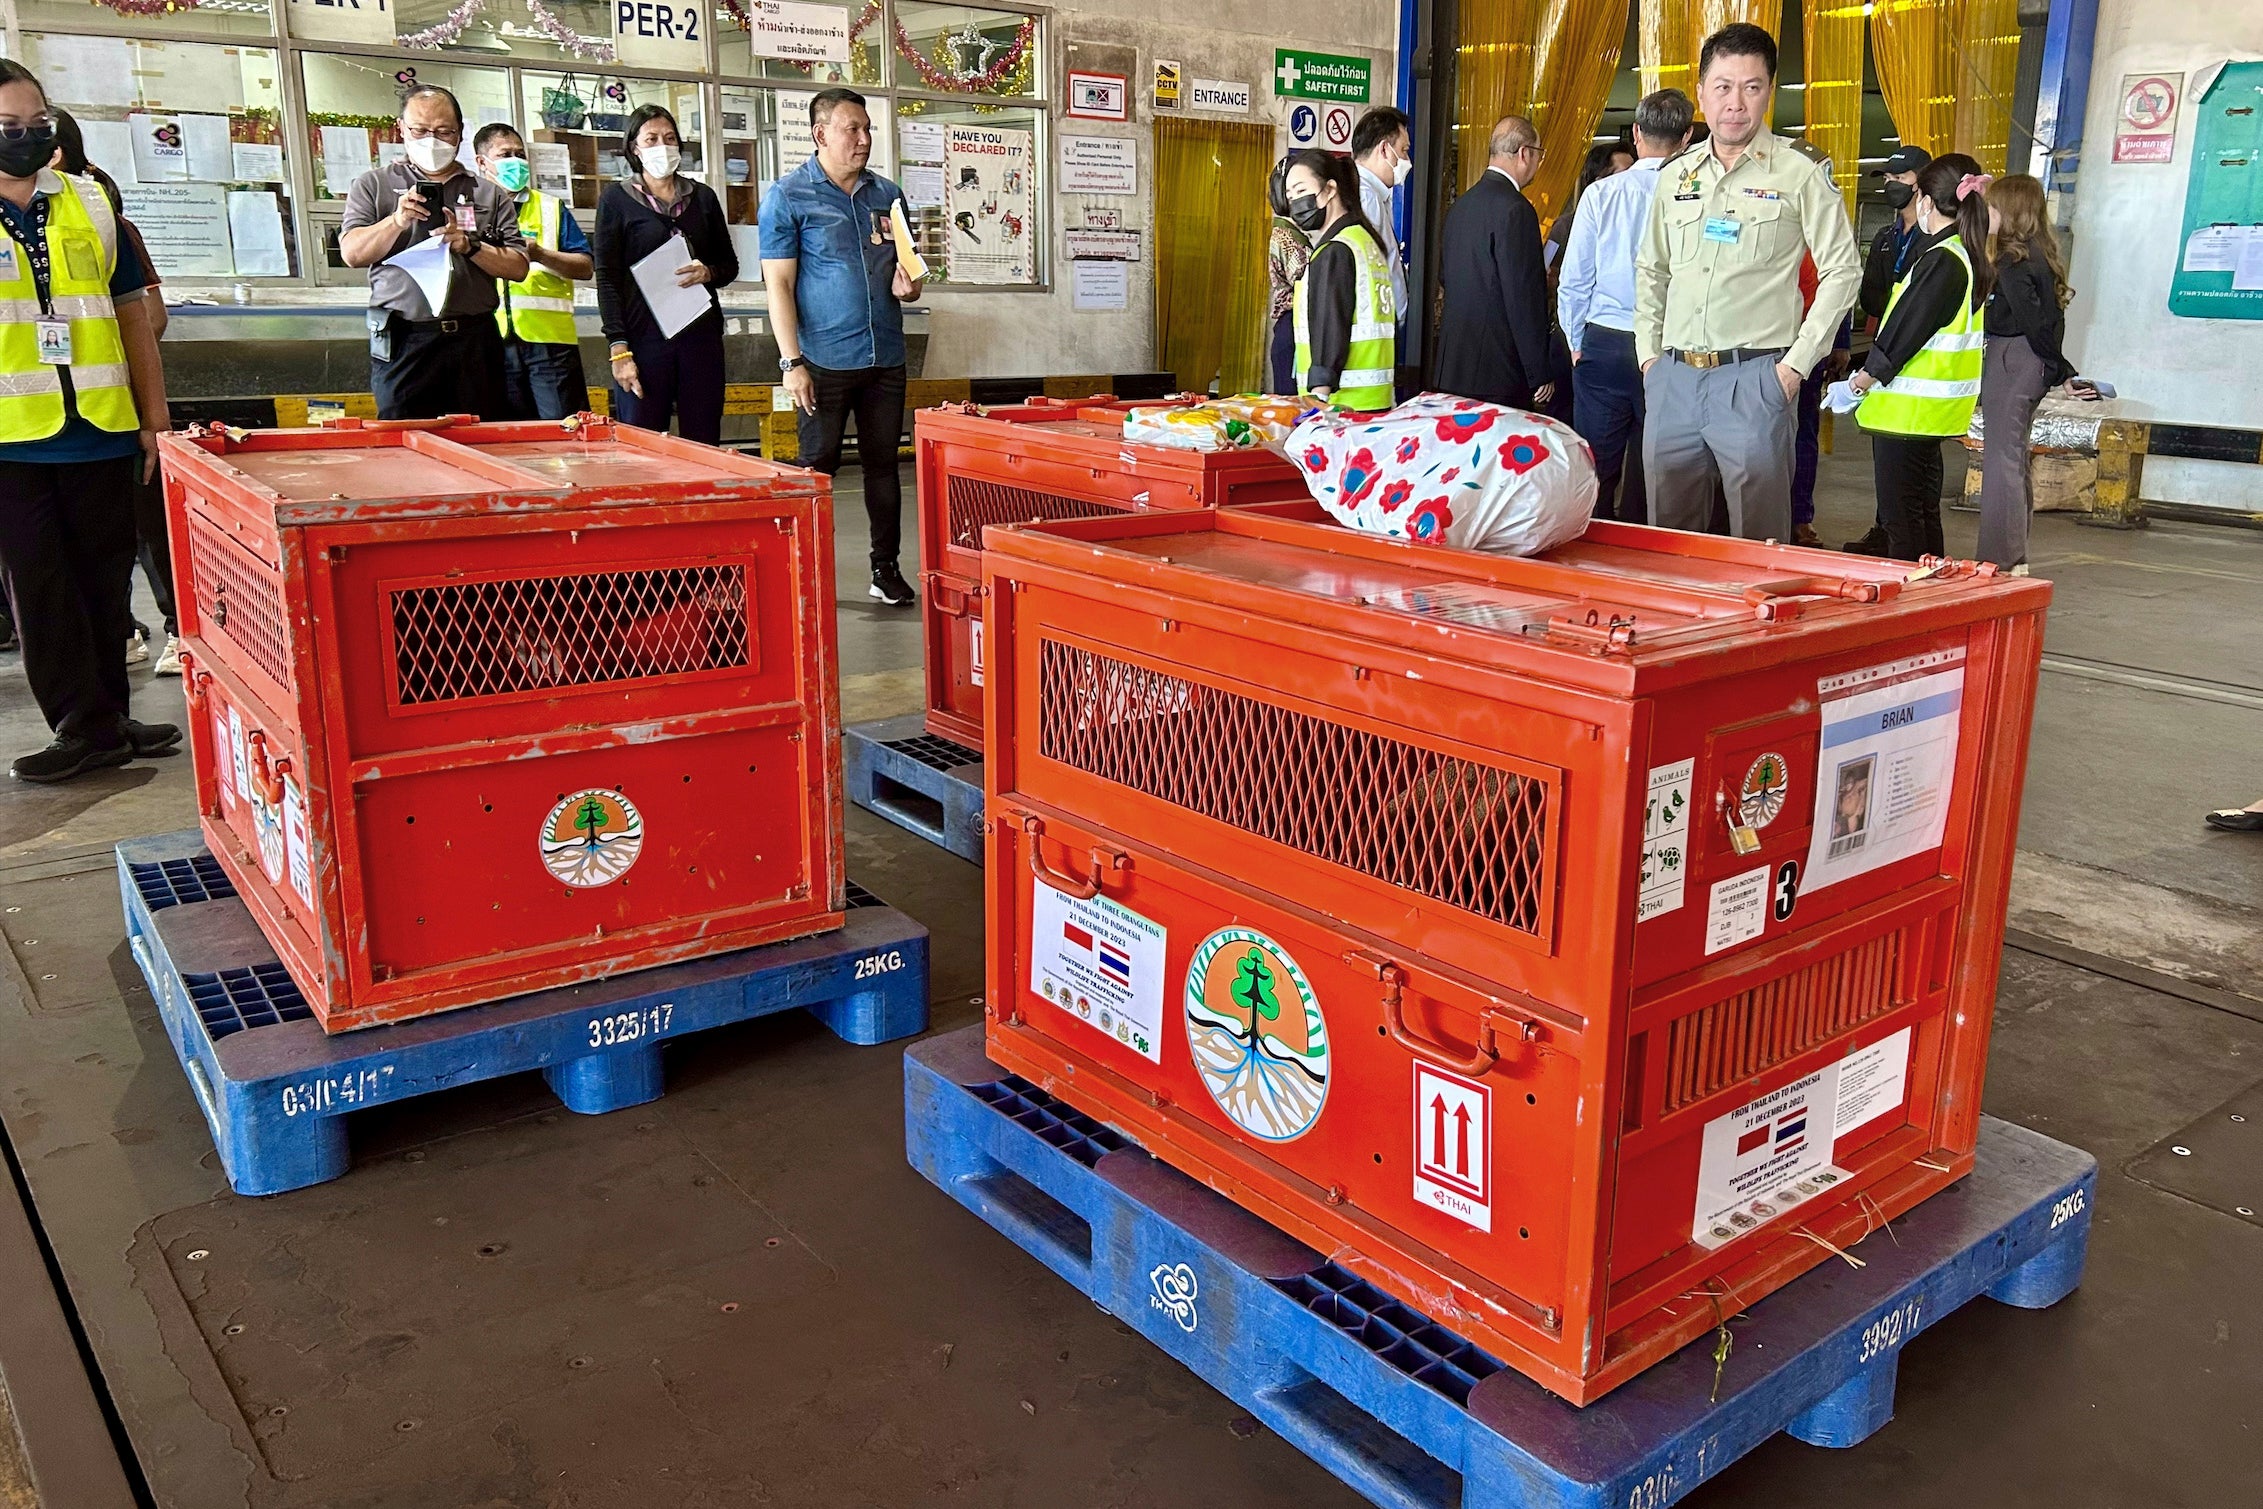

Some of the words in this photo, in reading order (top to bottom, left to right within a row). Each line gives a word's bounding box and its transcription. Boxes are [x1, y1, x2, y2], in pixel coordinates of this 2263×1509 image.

[763, 2, 780, 10] THAI
[618, 1, 699, 41] PER-2
[1304, 60, 1367, 80] ปลอดภัยไว้ก่อน
[1157, 79, 1178, 89] CCTV
[1194, 89, 1247, 106] ENTRANCE
[1305, 80, 1338, 94] SAFETY
[1339, 84, 1364, 97] FIRST
[953, 130, 980, 142] HAVE
[983, 133, 1002, 144] YOU
[953, 142, 1006, 156] DECLARED
[1008, 146, 1022, 156] IT?
[1075, 141, 1101, 149] Entrance
[154, 148, 184, 156] CARGO
[1087, 211, 1117, 228] ทางเข้า
[1881, 706, 1914, 730] BRIAN
[1651, 767, 1690, 785] ANIMALS
[1717, 882, 1738, 894] GARUDA
[1739, 873, 1764, 887] INDONESIA
[1774, 859, 1799, 923] 3
[1056, 891, 1071, 905] FROM
[1073, 900, 1099, 920] THAILAND
[1101, 914, 1108, 925] TO
[1110, 919, 1141, 942] INDONESIA
[1092, 897, 1100, 908] OF
[1101, 901, 1119, 917] THREE
[1121, 911, 1160, 938] ORANGUTANS
[1646, 899, 1664, 912] THAI
[1069, 911, 1076, 921] 21
[1078, 916, 1108, 938] DECEMBER
[1110, 932, 1126, 948] 2023
[855, 951, 907, 981] 25KG.
[1058, 952, 1084, 971] TOGETHER
[1085, 967, 1093, 976] WE
[1094, 972, 1109, 986] FIGHT
[1110, 981, 1134, 999] AGAINST
[1066, 966, 1089, 984] WILDLIFE
[1090, 980, 1125, 1004] TRAFFICKING
[588, 1003, 674, 1048] 3325/17
[1731, 1105, 1749, 1120] FROM
[1750, 1091, 1780, 1111] THAILAND
[1781, 1087, 1789, 1097] TO
[1790, 1073, 1820, 1094] INDONESIA
[1745, 1117, 1753, 1128] 21
[1755, 1102, 1787, 1124] DECEMBER
[1788, 1094, 1804, 1108] 2023
[1728, 1167, 1758, 1186] TOGETHER
[1759, 1162, 1768, 1171] WE
[1768, 1154, 1784, 1166] FIGHT
[1784, 1142, 1808, 1158] AGAINST
[1736, 1175, 1762, 1193] WILDLIFE
[1763, 1157, 1799, 1179] TRAFFICKING
[1445, 1194, 1471, 1215] THAI
[2050, 1187, 2086, 1231] 25KG.
[1149, 1293, 1174, 1320] THAI
[1859, 1293, 1924, 1364] 3992/17
